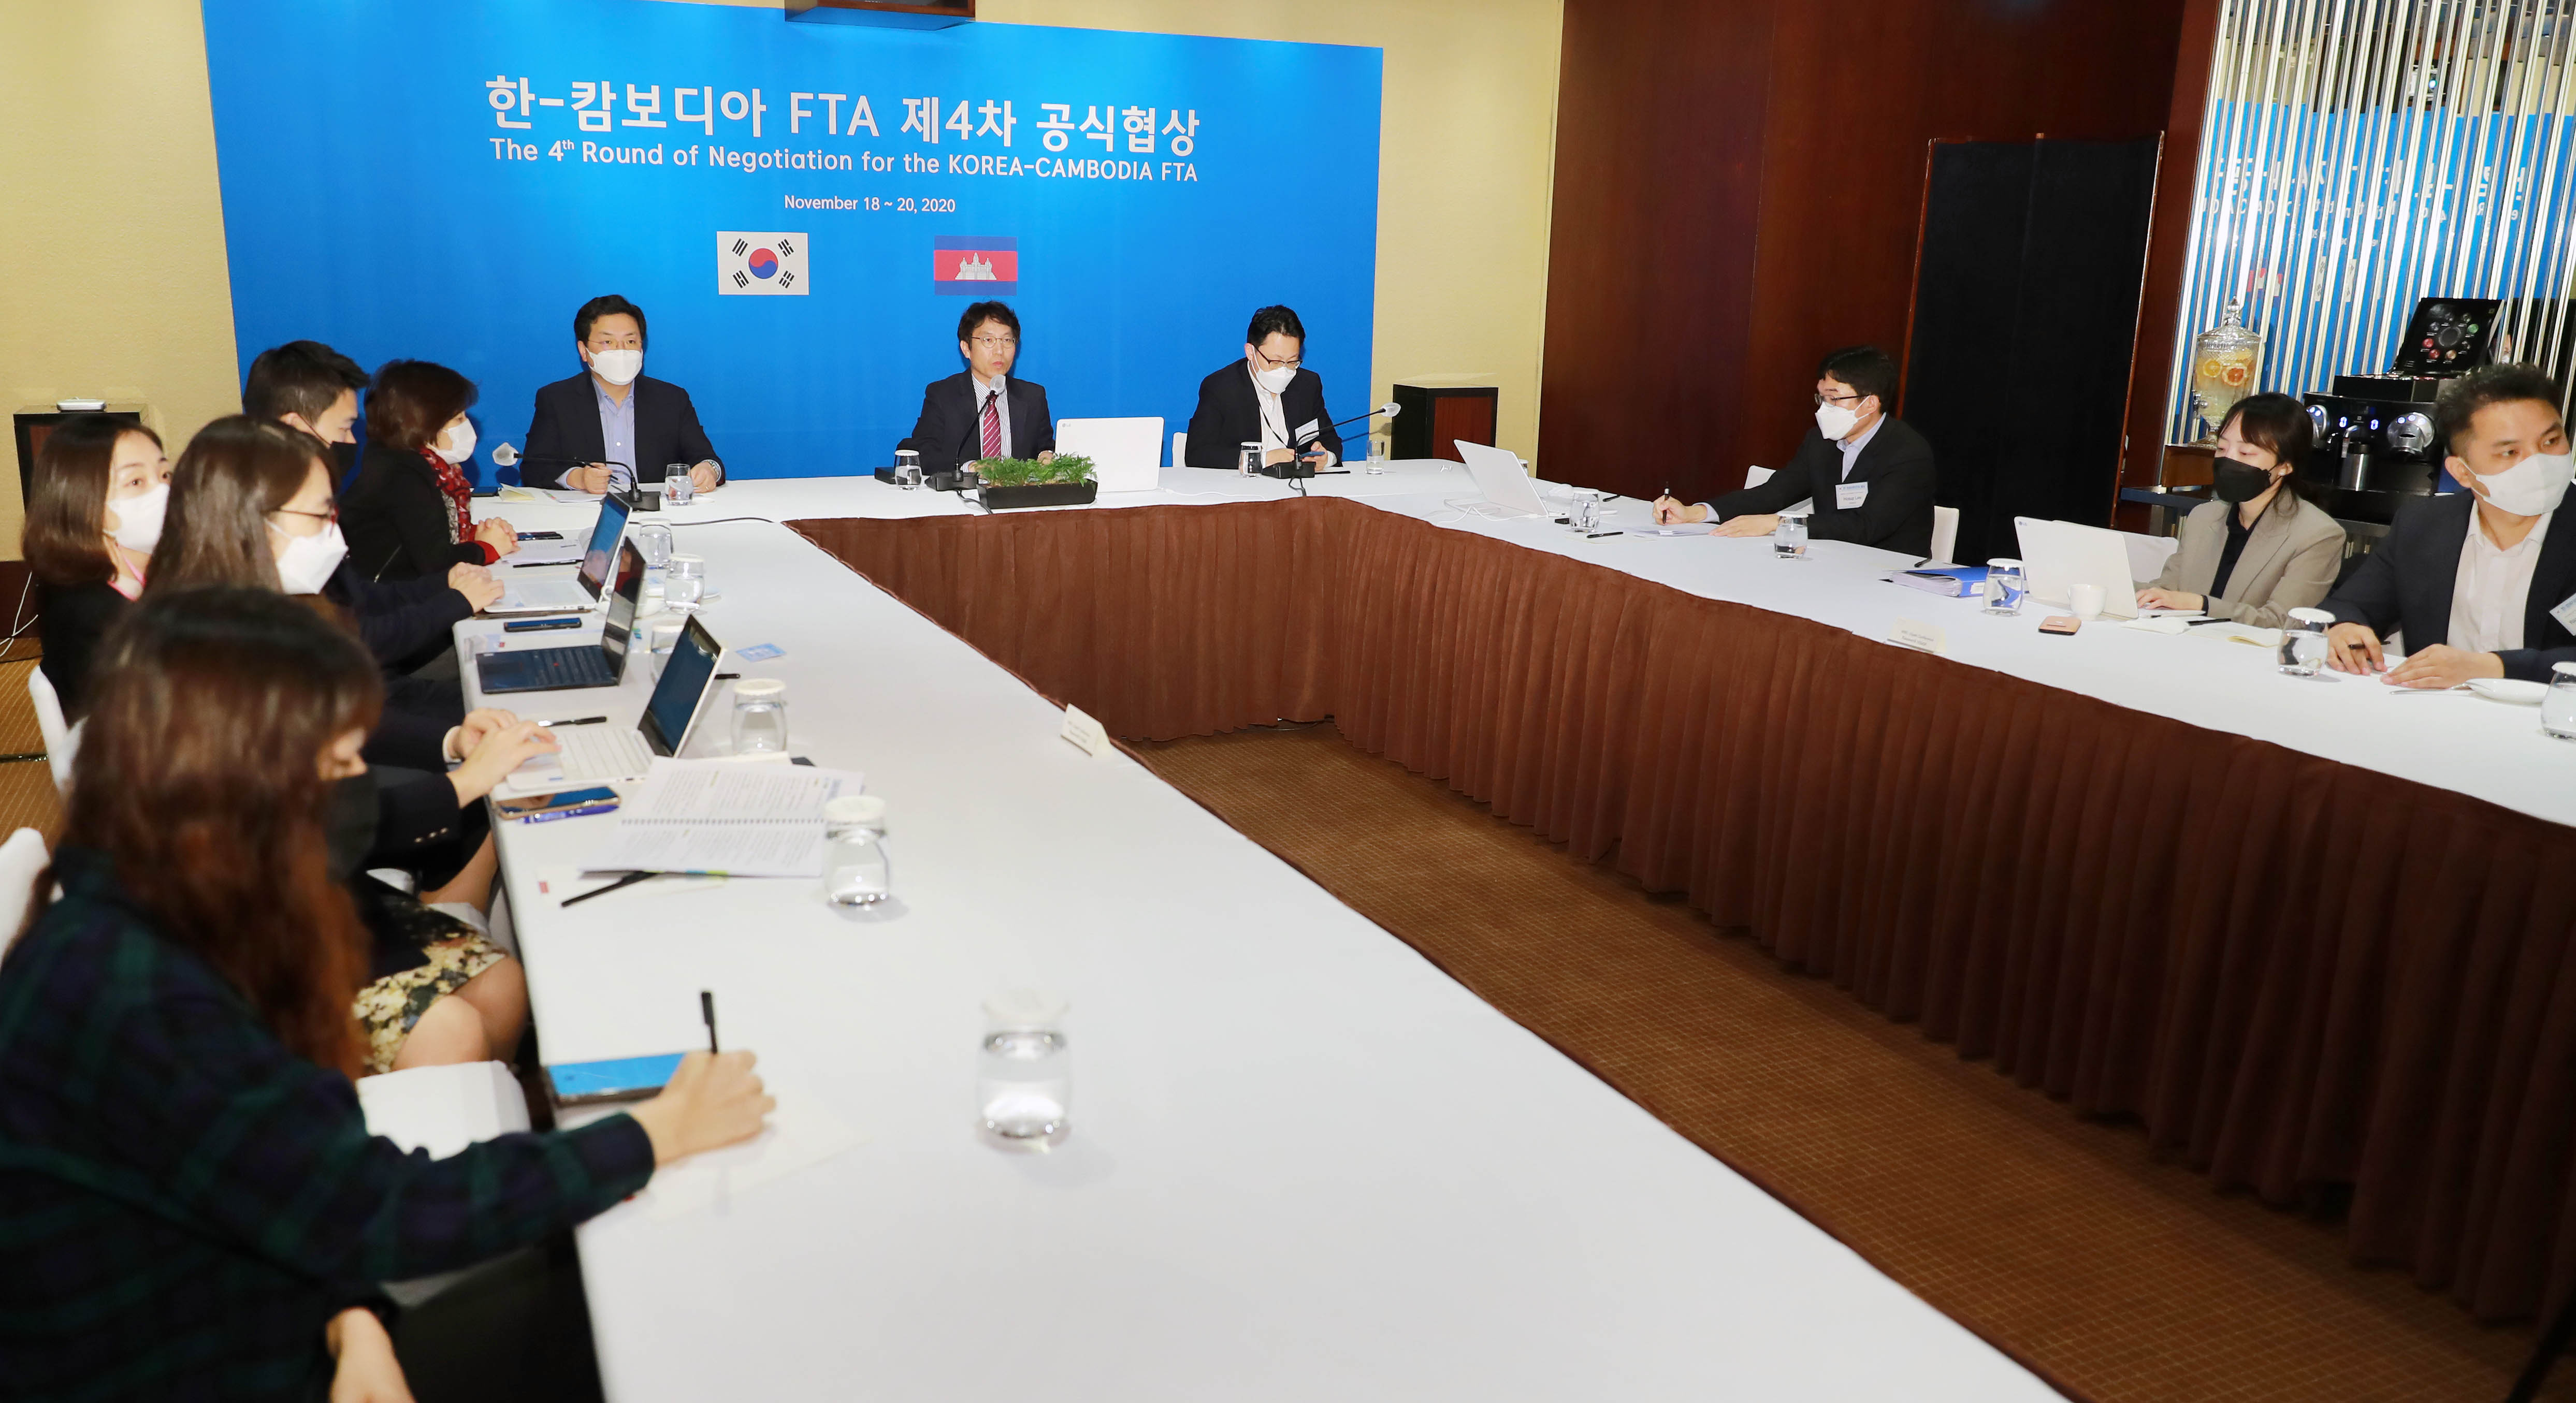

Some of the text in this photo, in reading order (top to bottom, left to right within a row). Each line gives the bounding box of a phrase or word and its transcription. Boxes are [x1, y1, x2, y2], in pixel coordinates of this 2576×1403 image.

[485, 75, 1200, 157] 한-캄보디아 FTA 제4차 공식협상
[489, 137, 538, 161] The
[582, 141, 663, 165] Round
[673, 144, 699, 166] of
[709, 145, 852, 173] Negotiation
[861, 151, 895, 172] for
[903, 152, 939, 173] the
[949, 154, 1153, 181] KOREA-CAMBODIA
[1162, 162, 1198, 182] FTA
[785, 194, 858, 210] November
[863, 197, 880, 211] 18
[897, 197, 918, 214] 20,
[921, 198, 956, 213] 2020
